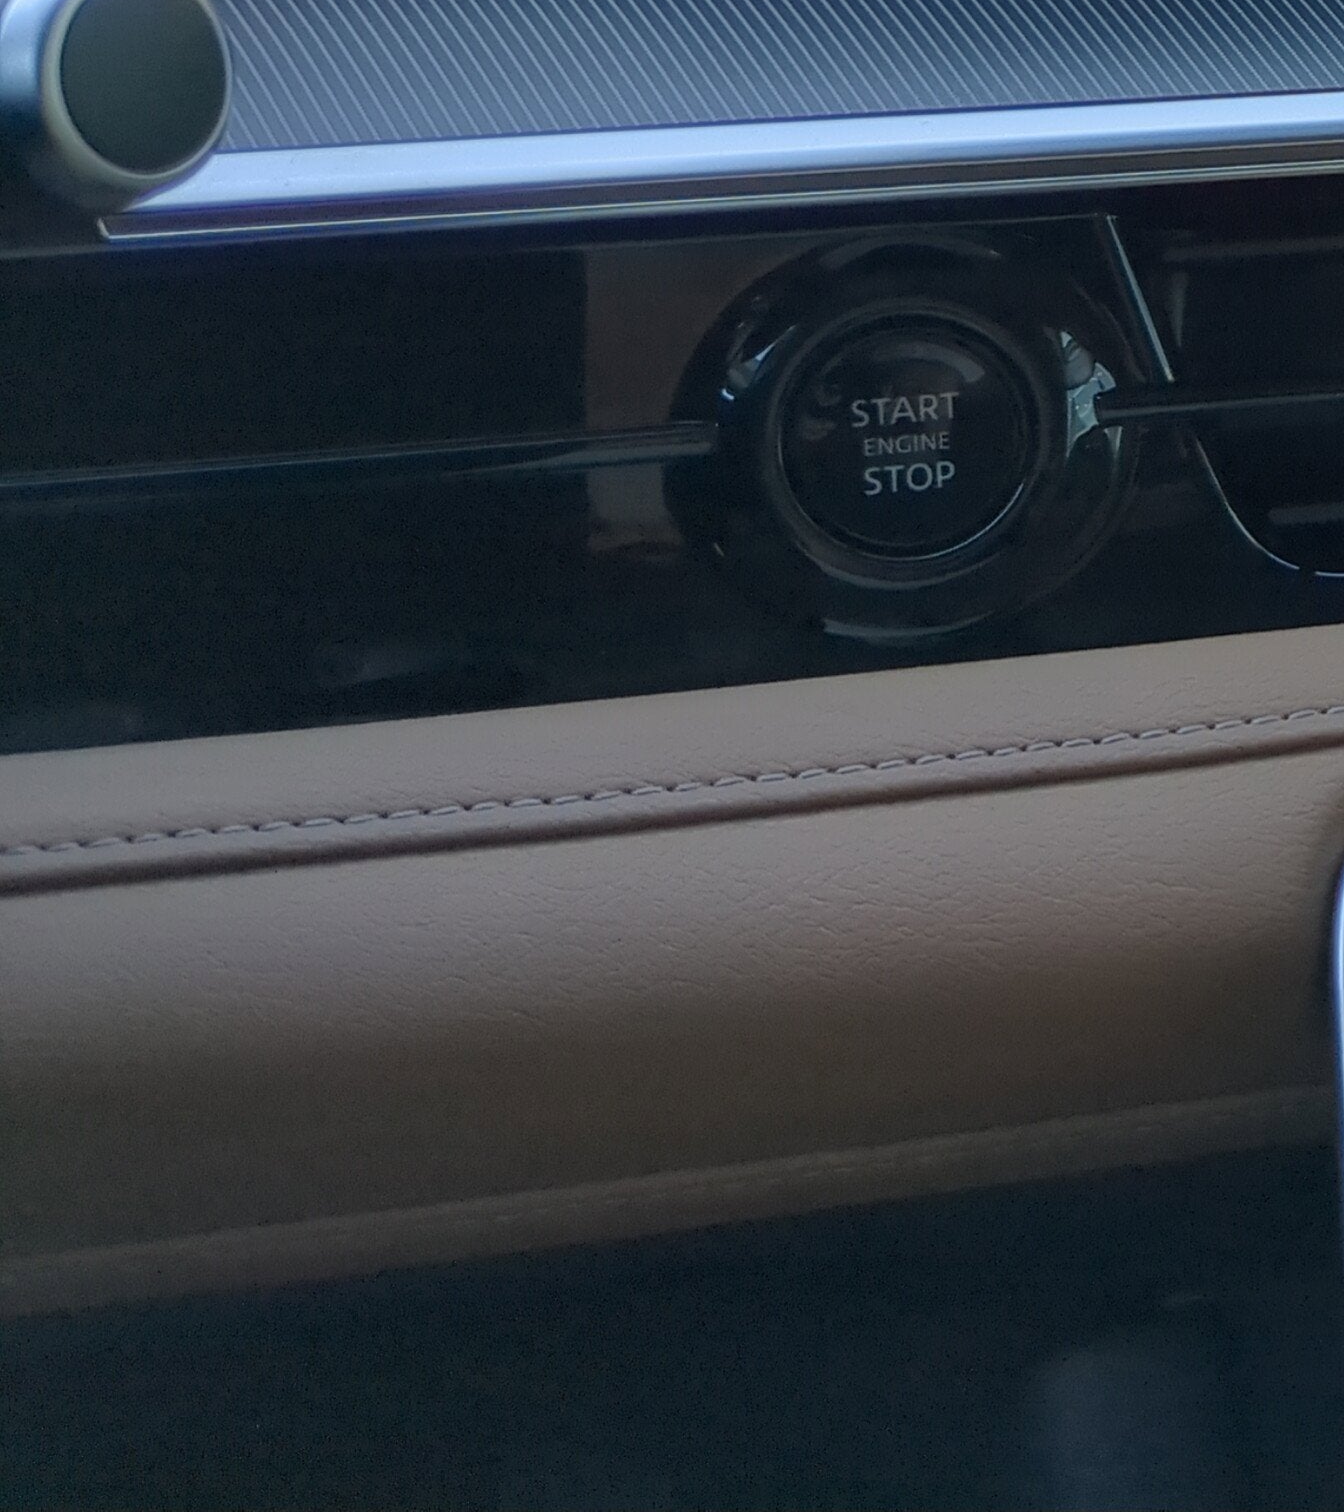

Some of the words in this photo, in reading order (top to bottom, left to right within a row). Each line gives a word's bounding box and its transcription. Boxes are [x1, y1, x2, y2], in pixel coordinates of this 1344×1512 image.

[849, 391, 960, 429] START
[862, 430, 951, 457] ENGINE
[863, 460, 956, 497] STOP
